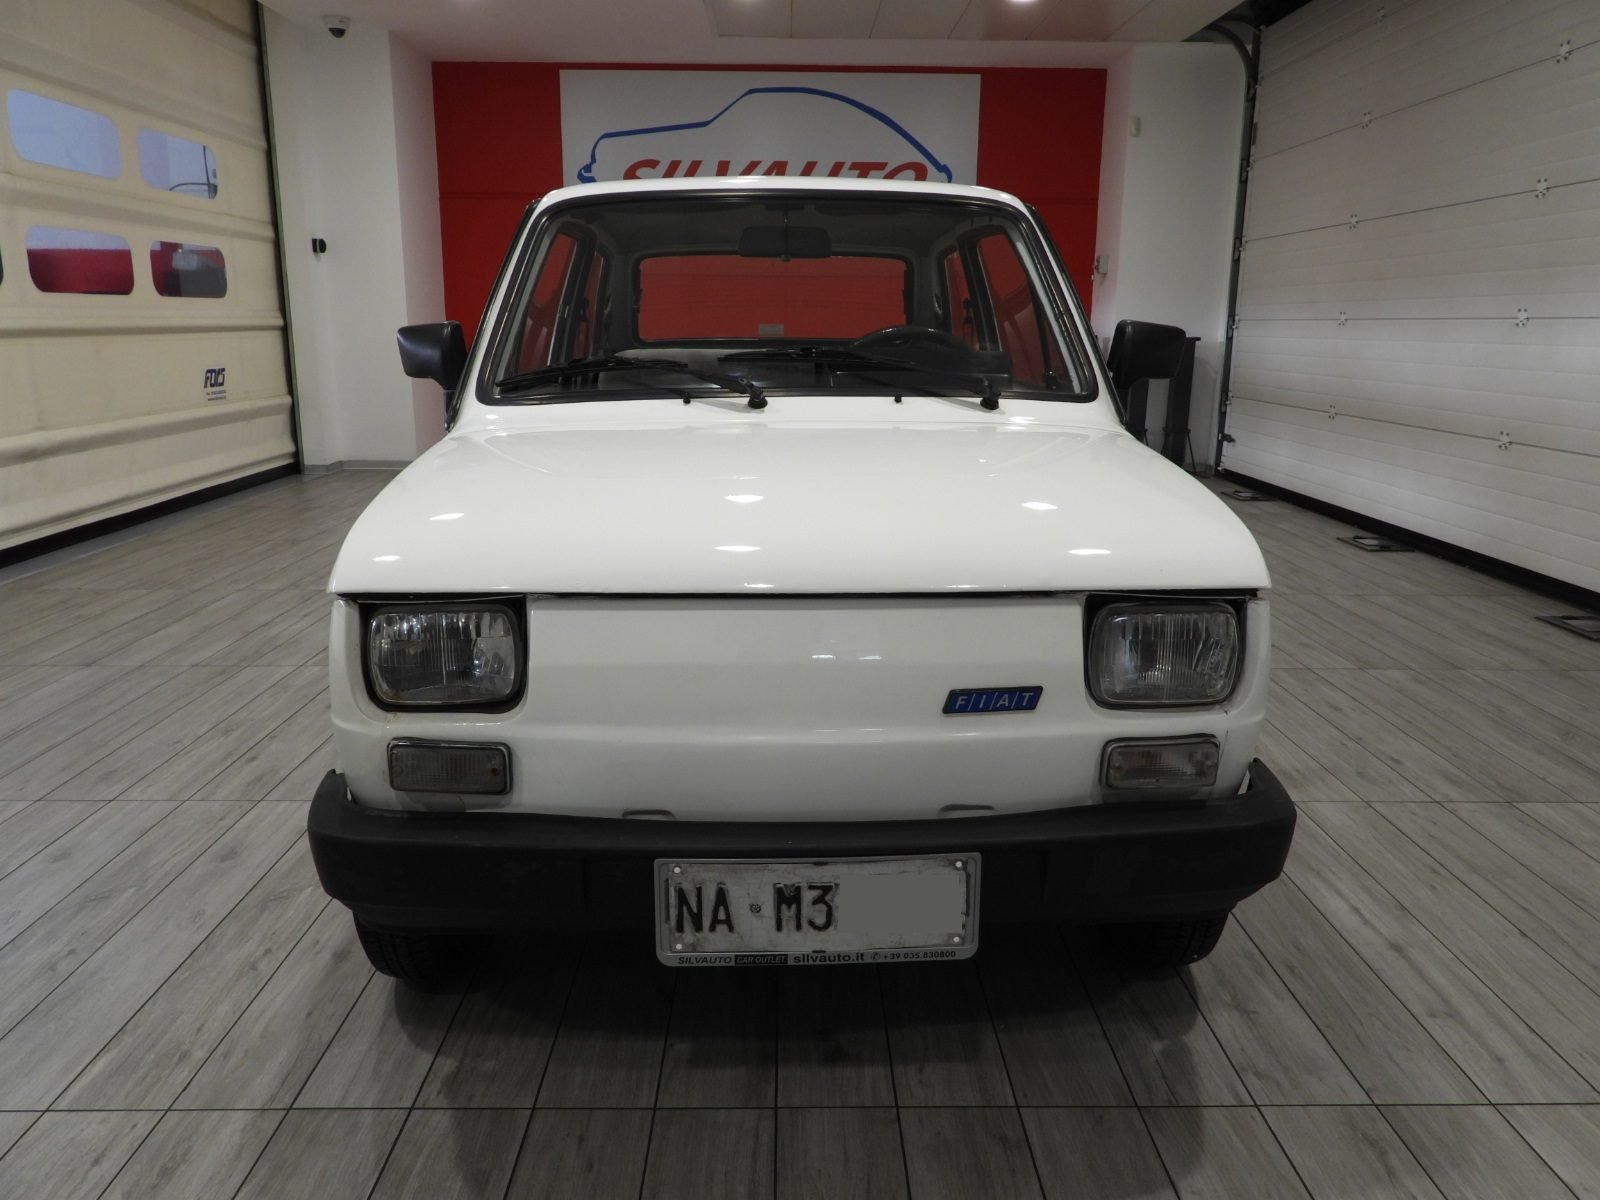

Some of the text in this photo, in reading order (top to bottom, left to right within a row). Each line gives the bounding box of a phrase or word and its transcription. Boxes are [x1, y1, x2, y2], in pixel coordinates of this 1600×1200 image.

[955, 692, 1034, 710] FIAT
[674, 883, 735, 933] NA
[678, 956, 732, 965] SILVAUTO
[737, 956, 753, 964] CAR
[755, 955, 785, 963] OUTLET
[793, 952, 864, 964] silvauto.it
[884, 952, 901, 960] +39
